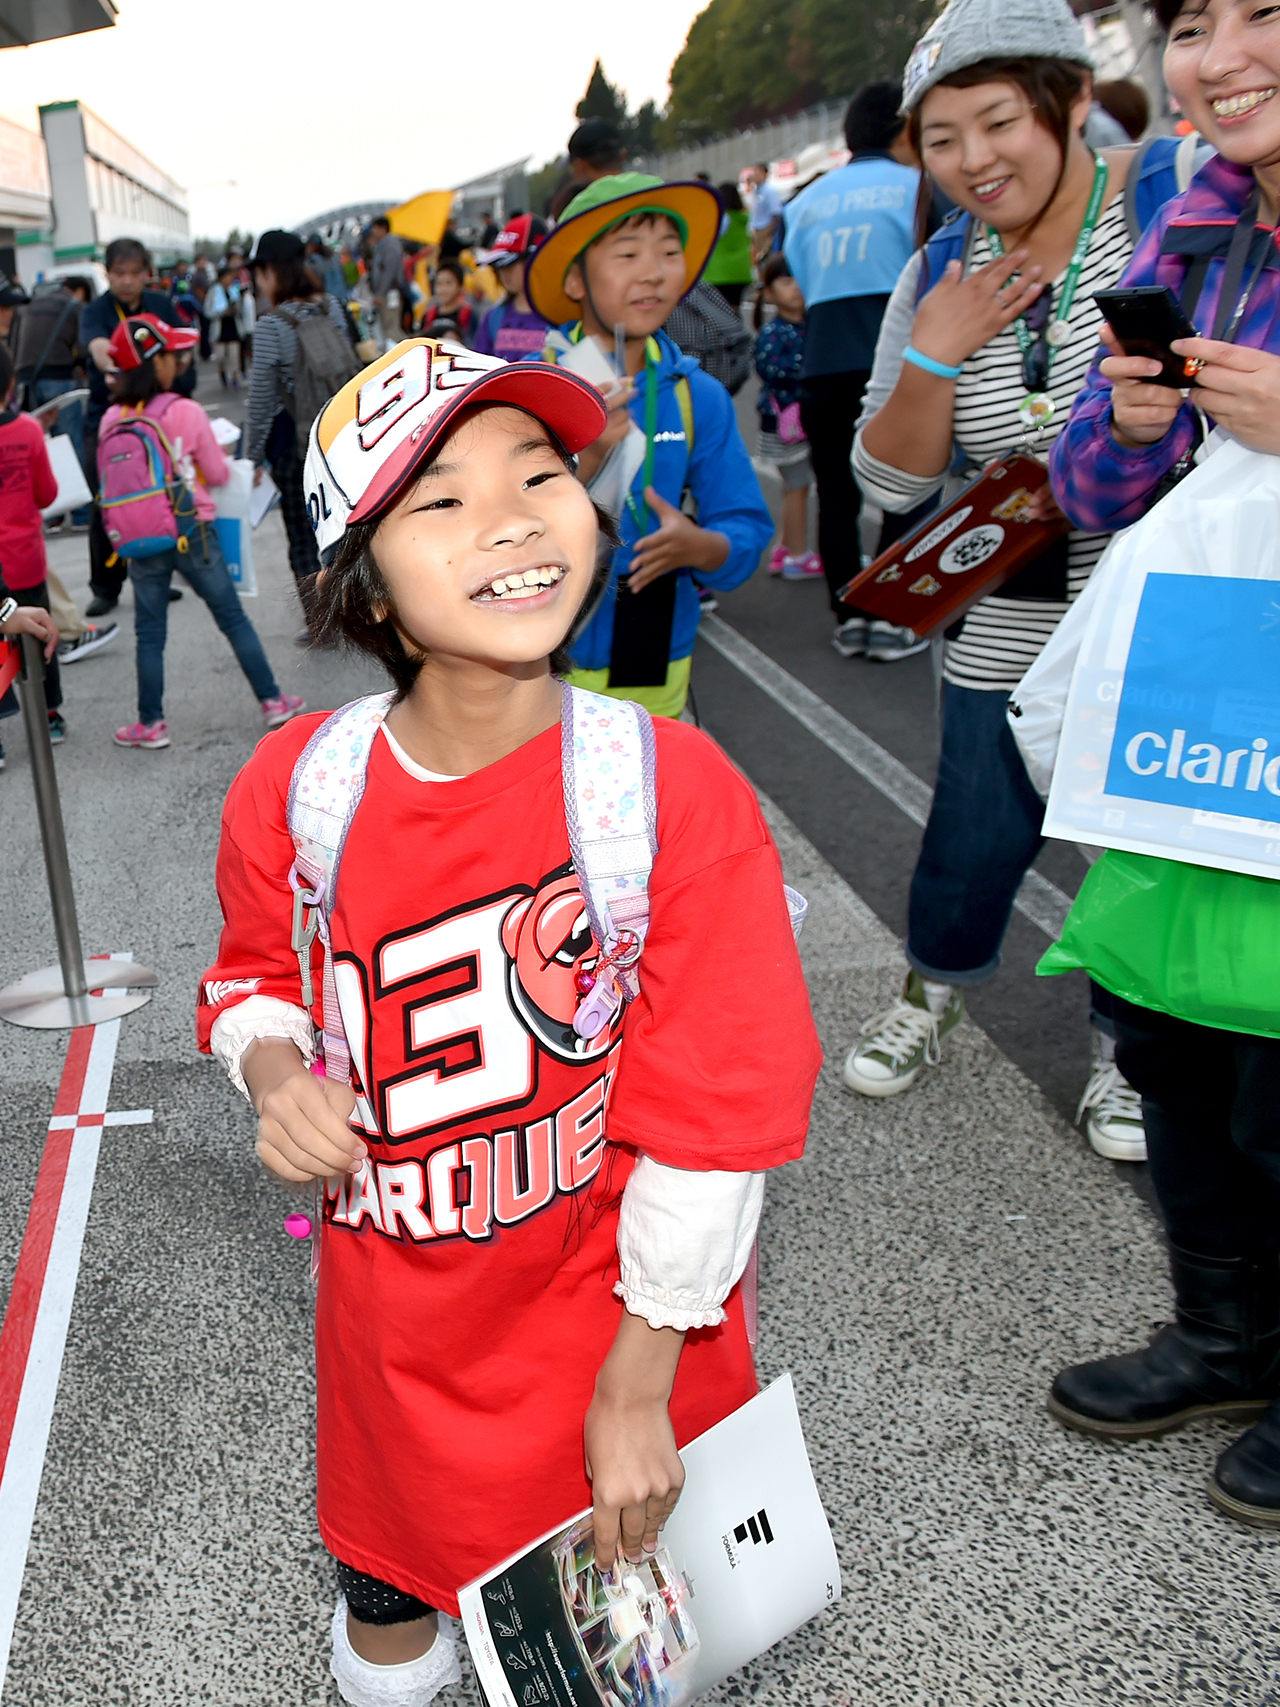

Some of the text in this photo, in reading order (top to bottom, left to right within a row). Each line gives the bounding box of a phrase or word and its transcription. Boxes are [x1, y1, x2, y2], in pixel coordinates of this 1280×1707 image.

[818, 223, 873, 269] 077
[1125, 728, 1280, 797] clari
[324, 1074, 612, 1242] MARQUE
[720, 1534, 737, 1570] FORMULA
[476, 1612, 485, 1636] HONDA
[483, 1641, 495, 1667] TOYOTA
